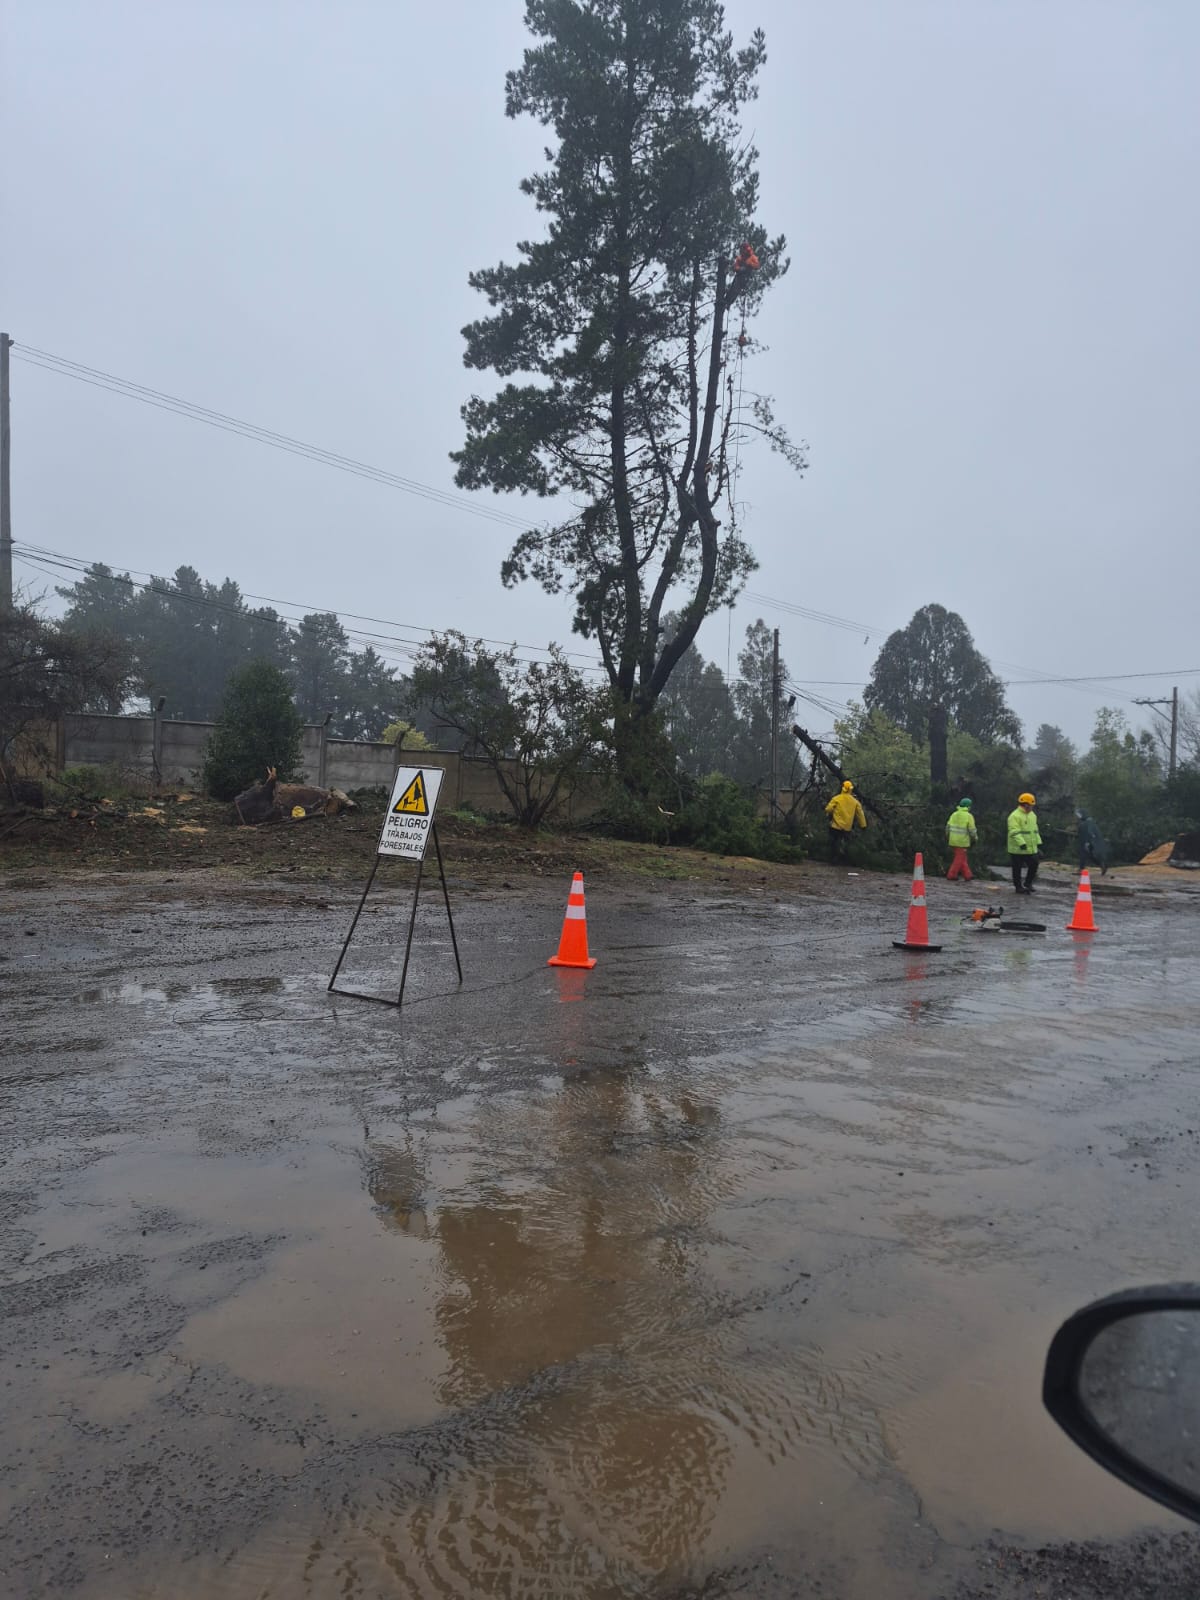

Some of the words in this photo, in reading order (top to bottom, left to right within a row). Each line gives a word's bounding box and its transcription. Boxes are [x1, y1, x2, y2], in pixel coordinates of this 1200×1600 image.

[388, 816, 428, 829] PELIGRO
[387, 829, 423, 841] TRABAJOS
[380, 840, 424, 852] FORESTALES
